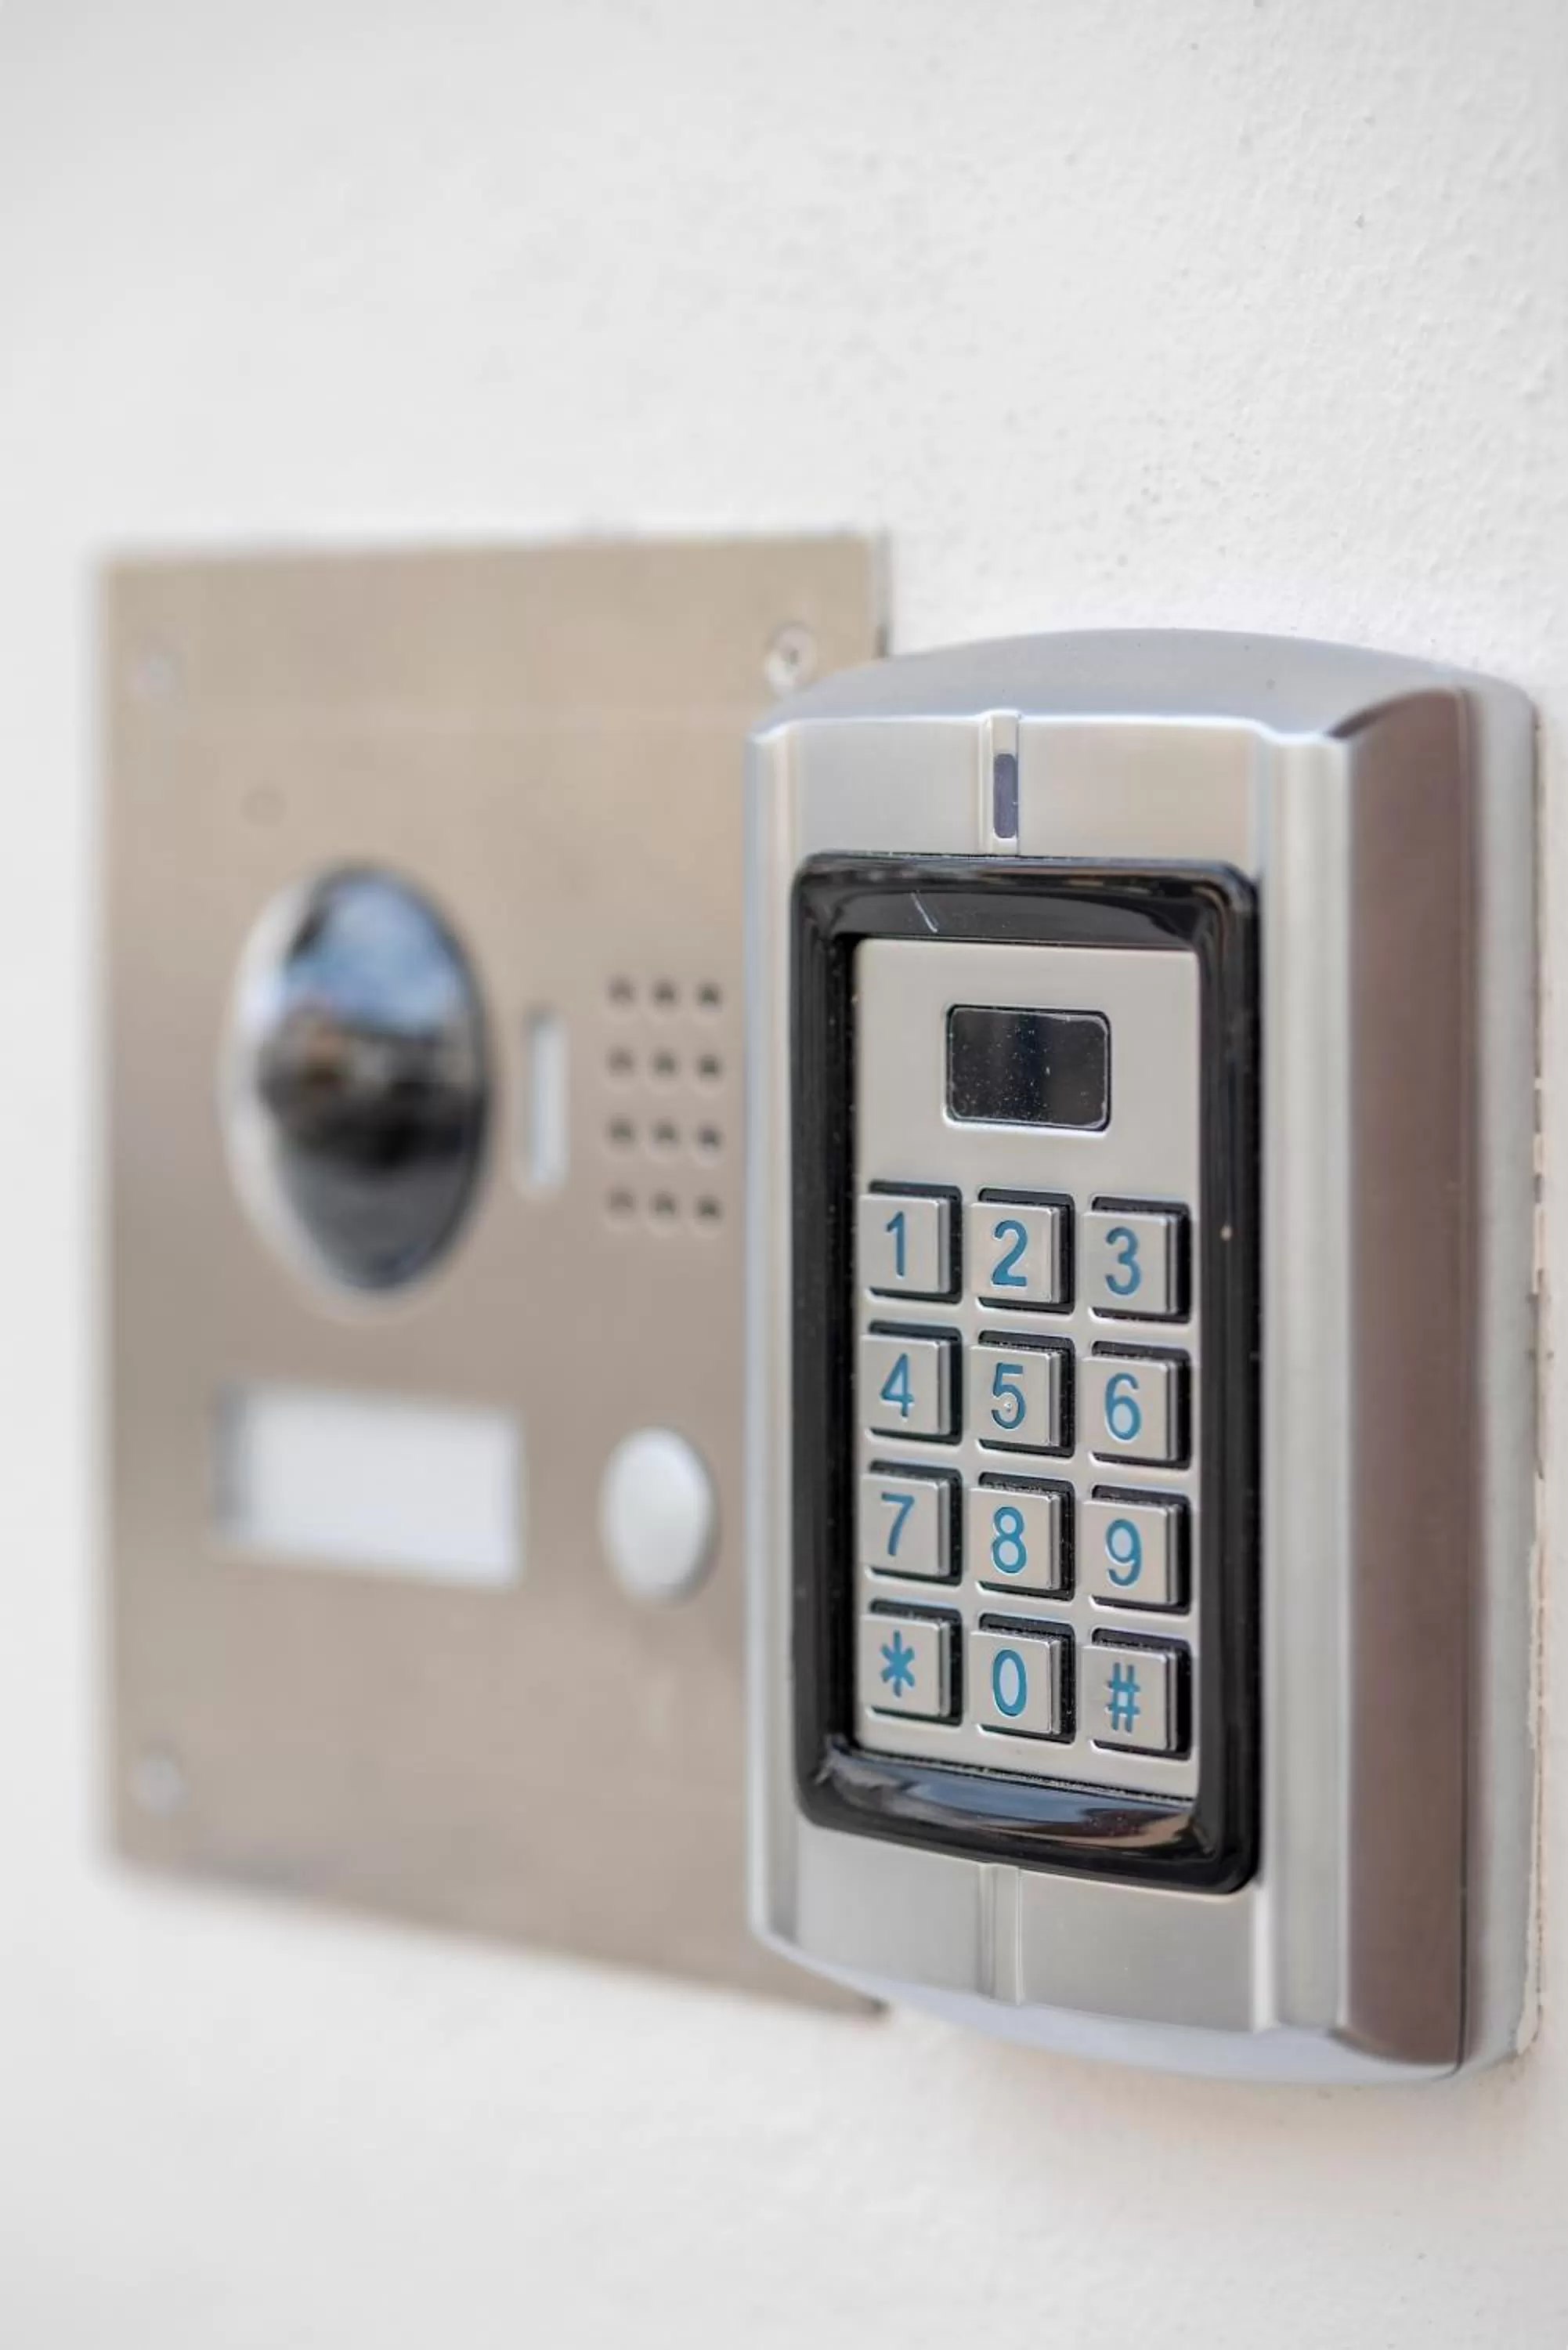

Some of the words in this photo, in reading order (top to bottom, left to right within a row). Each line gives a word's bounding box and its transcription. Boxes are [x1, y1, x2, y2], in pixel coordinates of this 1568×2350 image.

[886, 1211, 906, 1278] 1
[991, 1220, 1028, 1287] 2
[1105, 1227, 1142, 1296] 3
[880, 1353, 914, 1419] 4
[992, 1361, 1026, 1430] 5
[1104, 1372, 1142, 1442] 6
[881, 1492, 915, 1556] 7
[992, 1506, 1028, 1574] 8
[1105, 1519, 1143, 1587] 9
[992, 1648, 1028, 1718] 0
[1107, 1662, 1140, 1733] #
